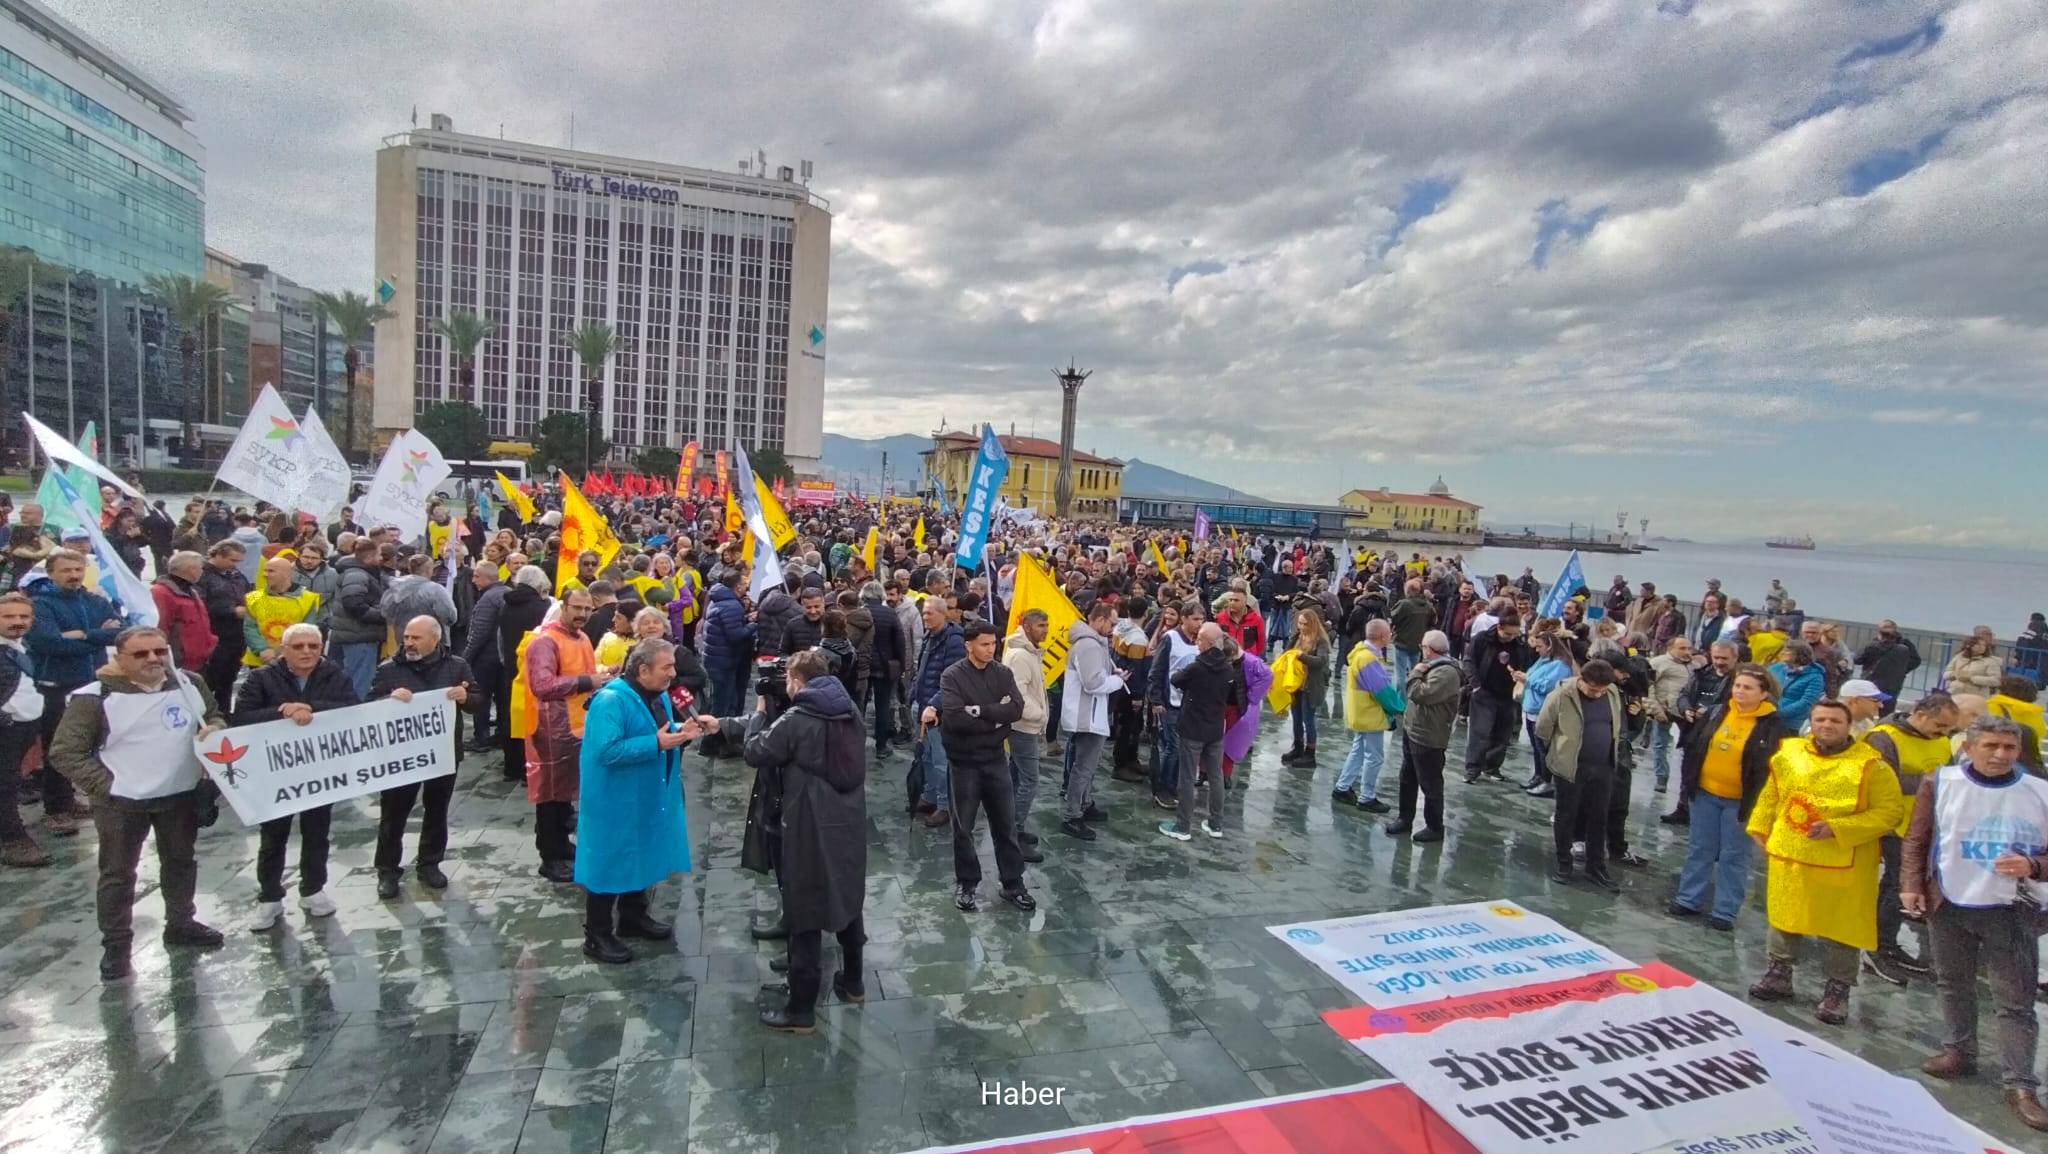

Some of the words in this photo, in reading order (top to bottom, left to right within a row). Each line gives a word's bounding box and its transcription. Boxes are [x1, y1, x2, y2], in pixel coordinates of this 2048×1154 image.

[552, 169, 594, 189] Türk
[601, 176, 679, 201] Telekom
[958, 463, 995, 558] KESK
[265, 739, 316, 772] İNSAN
[317, 729, 384, 760] HAKLARI
[388, 705, 447, 746] DERNEĞİ
[274, 772, 348, 803] AYDIN
[356, 749, 437, 785] ŞUBESİ
[1470, 932, 1574, 955] YARARINA
[1555, 1009, 1744, 1065] EMEKÇİYE
[1428, 1041, 1580, 1091] BÜTÇE
[1600, 1049, 1772, 1111] MAYEYE
[1456, 1085, 1630, 1144] DEĞİL,
[1736, 1128, 1802, 1149] NOLU
